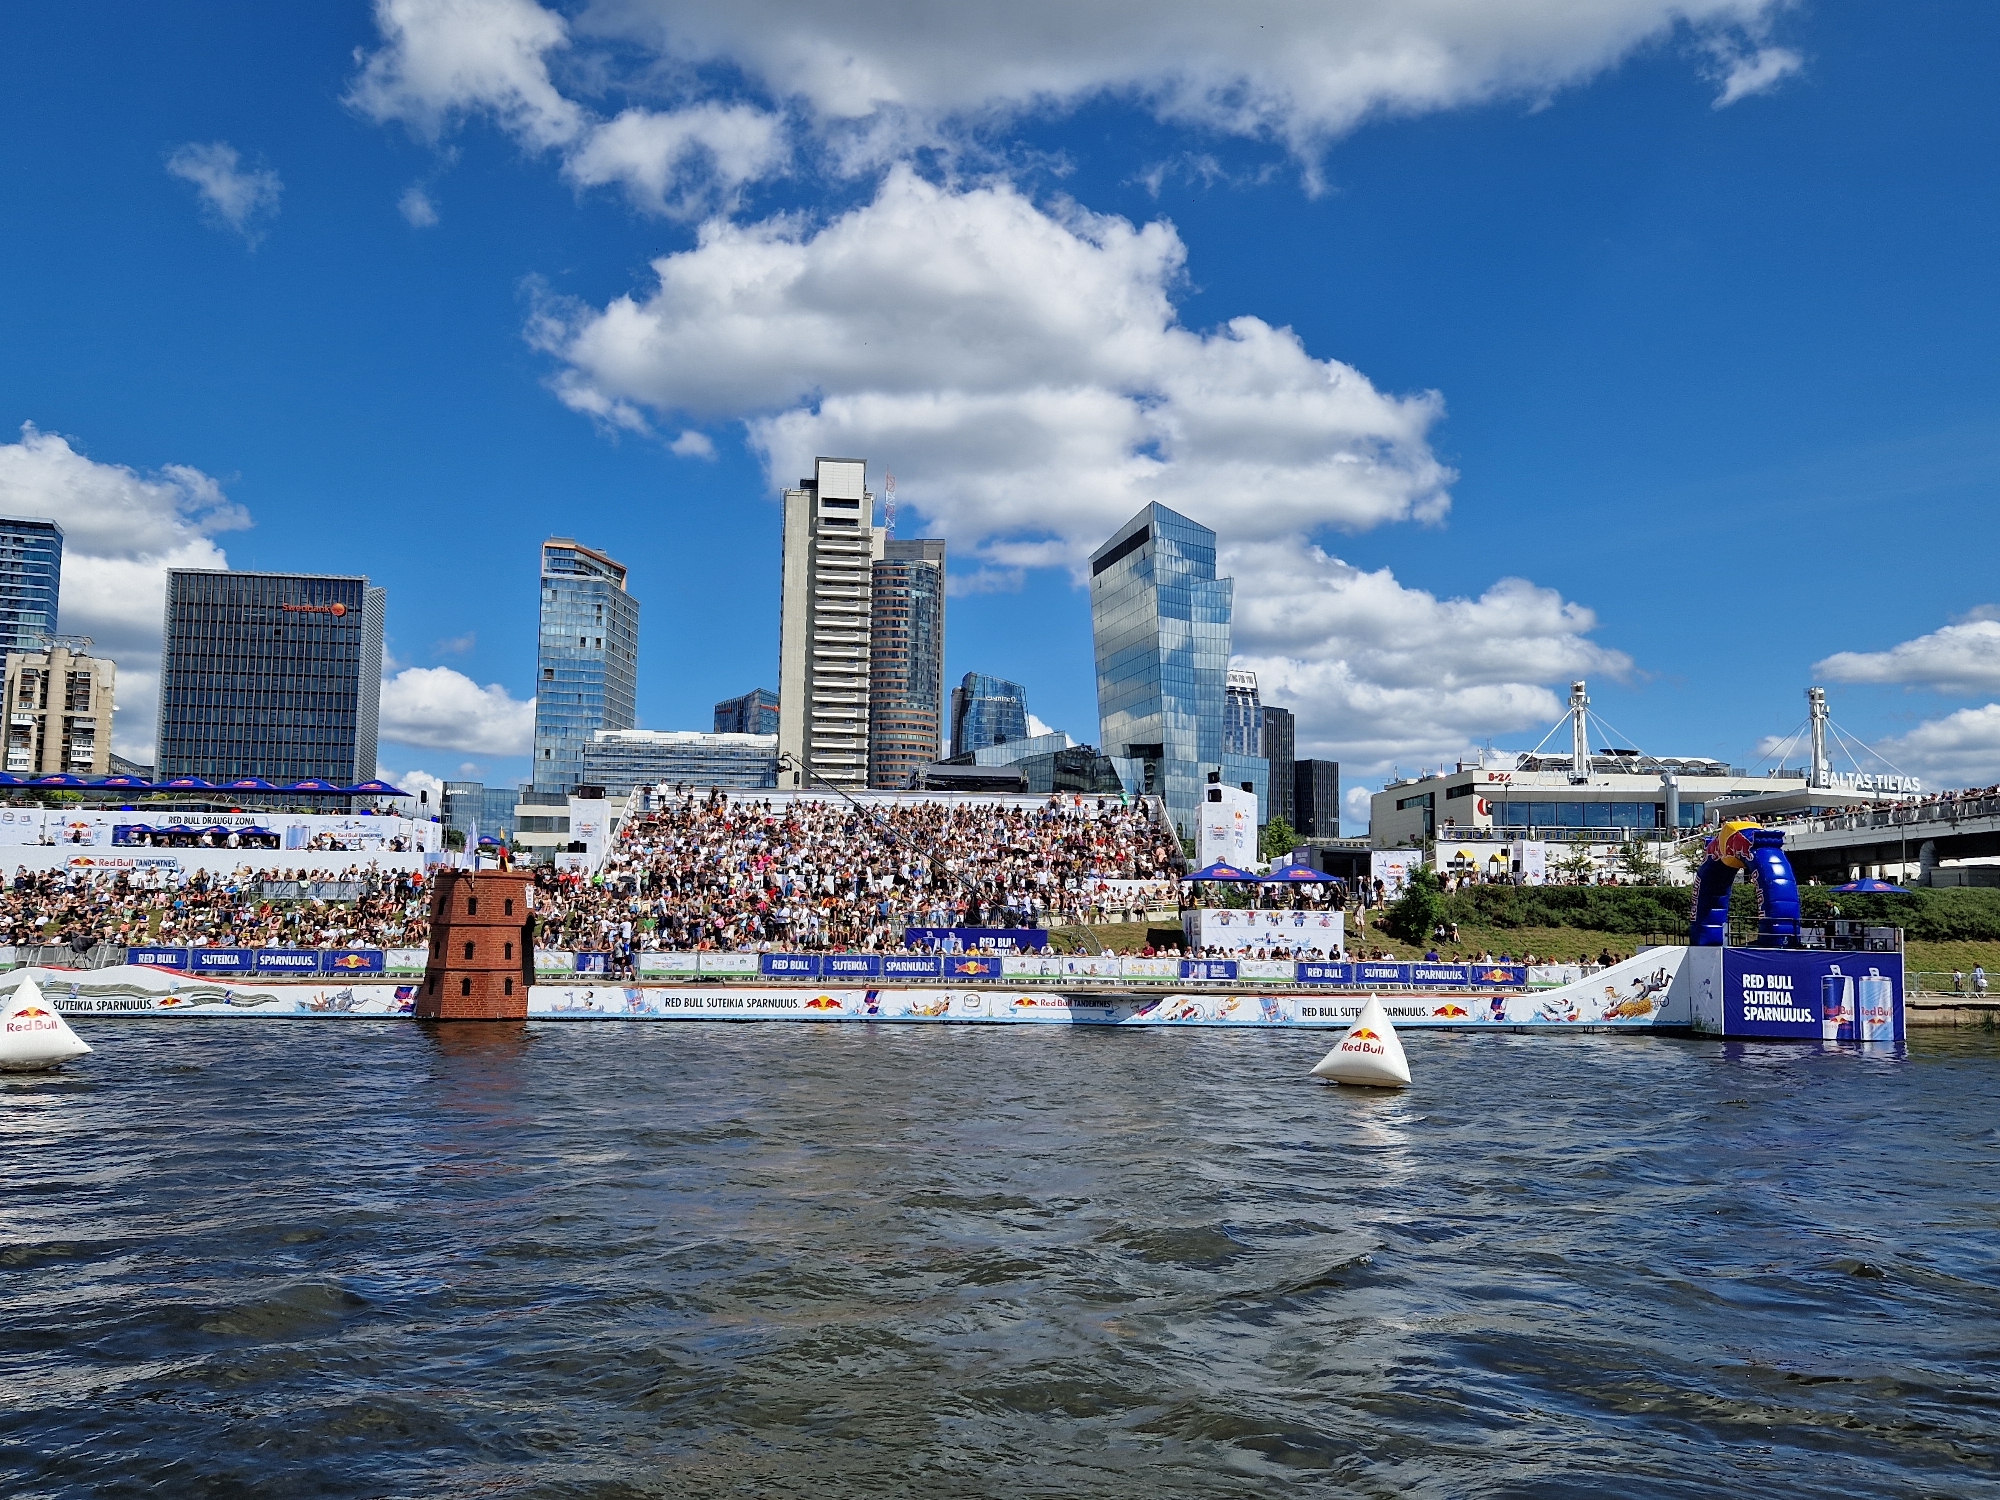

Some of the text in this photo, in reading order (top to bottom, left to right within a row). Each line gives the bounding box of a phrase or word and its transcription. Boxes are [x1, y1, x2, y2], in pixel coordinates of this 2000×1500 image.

[282, 602, 330, 613] Swedbank
[1819, 770, 1921, 792] BALTAS TILTAS
[168, 816, 182, 824] RED
[183, 816, 200, 825] BULL
[234, 817, 256, 826] ZONA
[98, 858, 116, 867] Red
[117, 858, 134, 867] Bull
[138, 953, 178, 964] RED BULL
[201, 955, 240, 965] SUTEIKIA
[259, 956, 316, 966] SPARNUUUS.
[771, 959, 810, 971] RED BULL
[832, 960, 868, 971] SUTEIKIA
[1307, 967, 1343, 979] RED BULL
[1364, 968, 1399, 978] SUTEIKIA
[1415, 970, 1465, 980] SPARNUUUS.
[1742, 974, 1794, 990] RED BULL
[664, 997, 801, 1009] RED BULL SUTEIKIA SPARNUUUS.
[1040, 999, 1056, 1007] Red
[1057, 999, 1073, 1008] Bull
[1743, 990, 1793, 1006] SUTEIKIA
[53, 1000, 155, 1011] SUTEIKIA SPARNUUUS.
[1302, 1007, 1317, 1017] RED
[1319, 1007, 1338, 1017] BULL
[1382, 1007, 1429, 1017] PARNUUUS.
[1743, 1006, 1816, 1023] SPARNUUUS.
[6, 1020, 58, 1033] Red Bull
[1341, 1042, 1385, 1055] Red Bull
